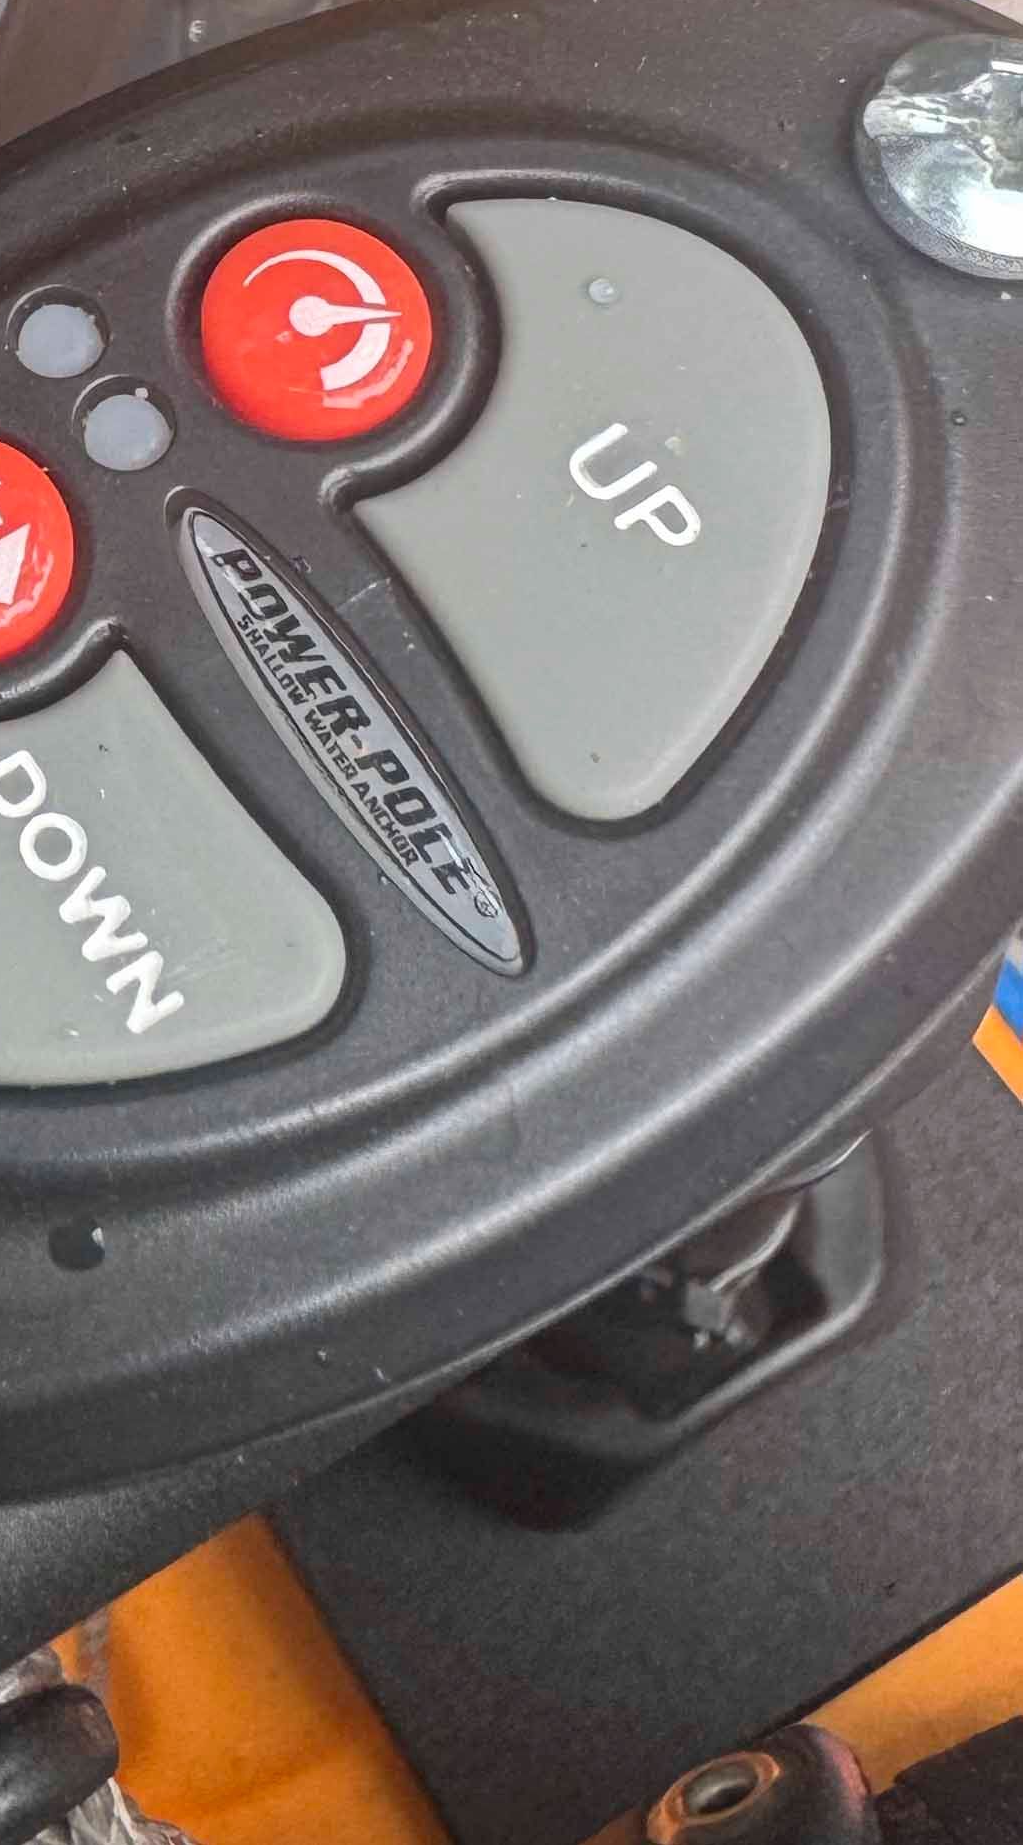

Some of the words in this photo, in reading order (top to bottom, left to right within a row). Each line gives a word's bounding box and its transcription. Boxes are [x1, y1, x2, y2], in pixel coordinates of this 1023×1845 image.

[569, 422, 701, 546] UP
[236, 614, 309, 709] SHALLOW
[304, 707, 359, 782] WATER
[350, 778, 418, 867] ANCHOR
